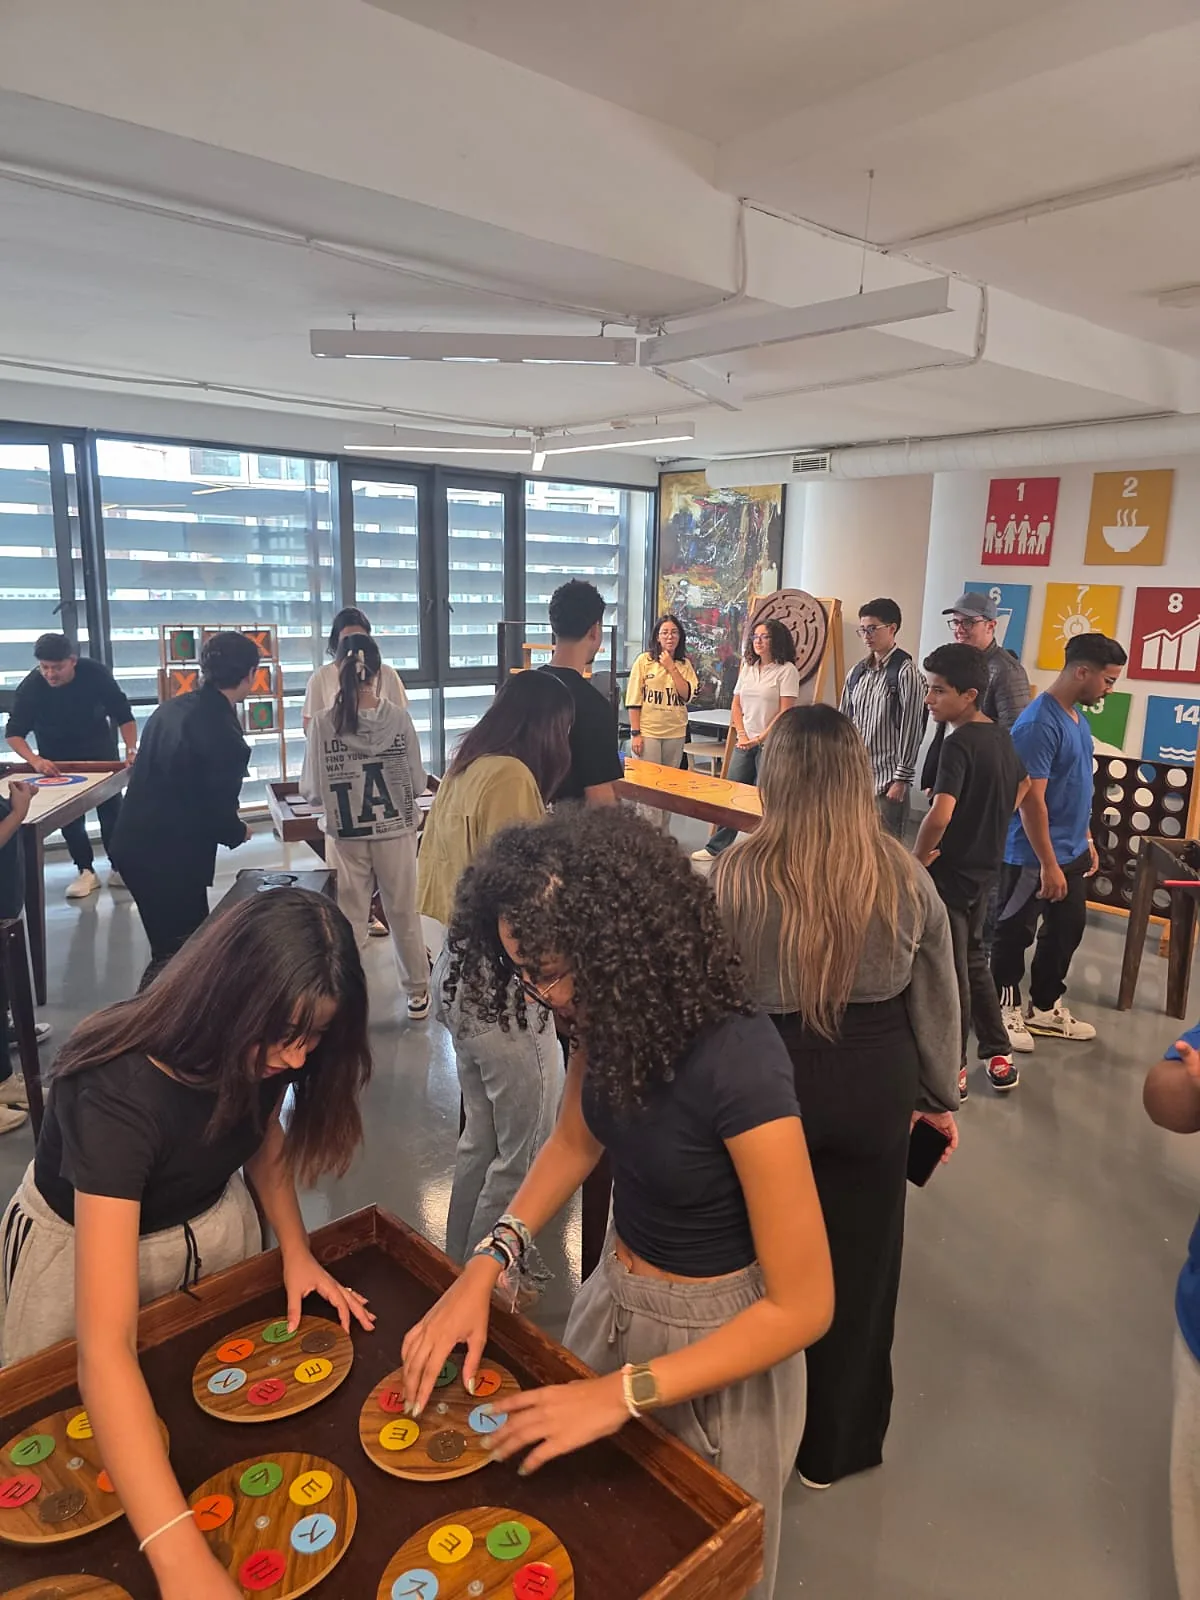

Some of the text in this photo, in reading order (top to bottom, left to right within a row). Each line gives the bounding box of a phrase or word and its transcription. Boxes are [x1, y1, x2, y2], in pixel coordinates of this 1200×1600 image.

[1016, 482, 1026, 501] 1
[1122, 477, 1138, 497] 2
[989, 587, 1001, 605] 6
[1076, 586, 1090, 603] 7
[1168, 593, 1183, 613] 8
[642, 685, 664, 704] New
[1082, 698, 1105, 714] 3
[1174, 704, 1200, 725] 14
[324, 739, 348, 753] LOS
[326, 763, 344, 772] WAY
[330, 762, 399, 837] LA
